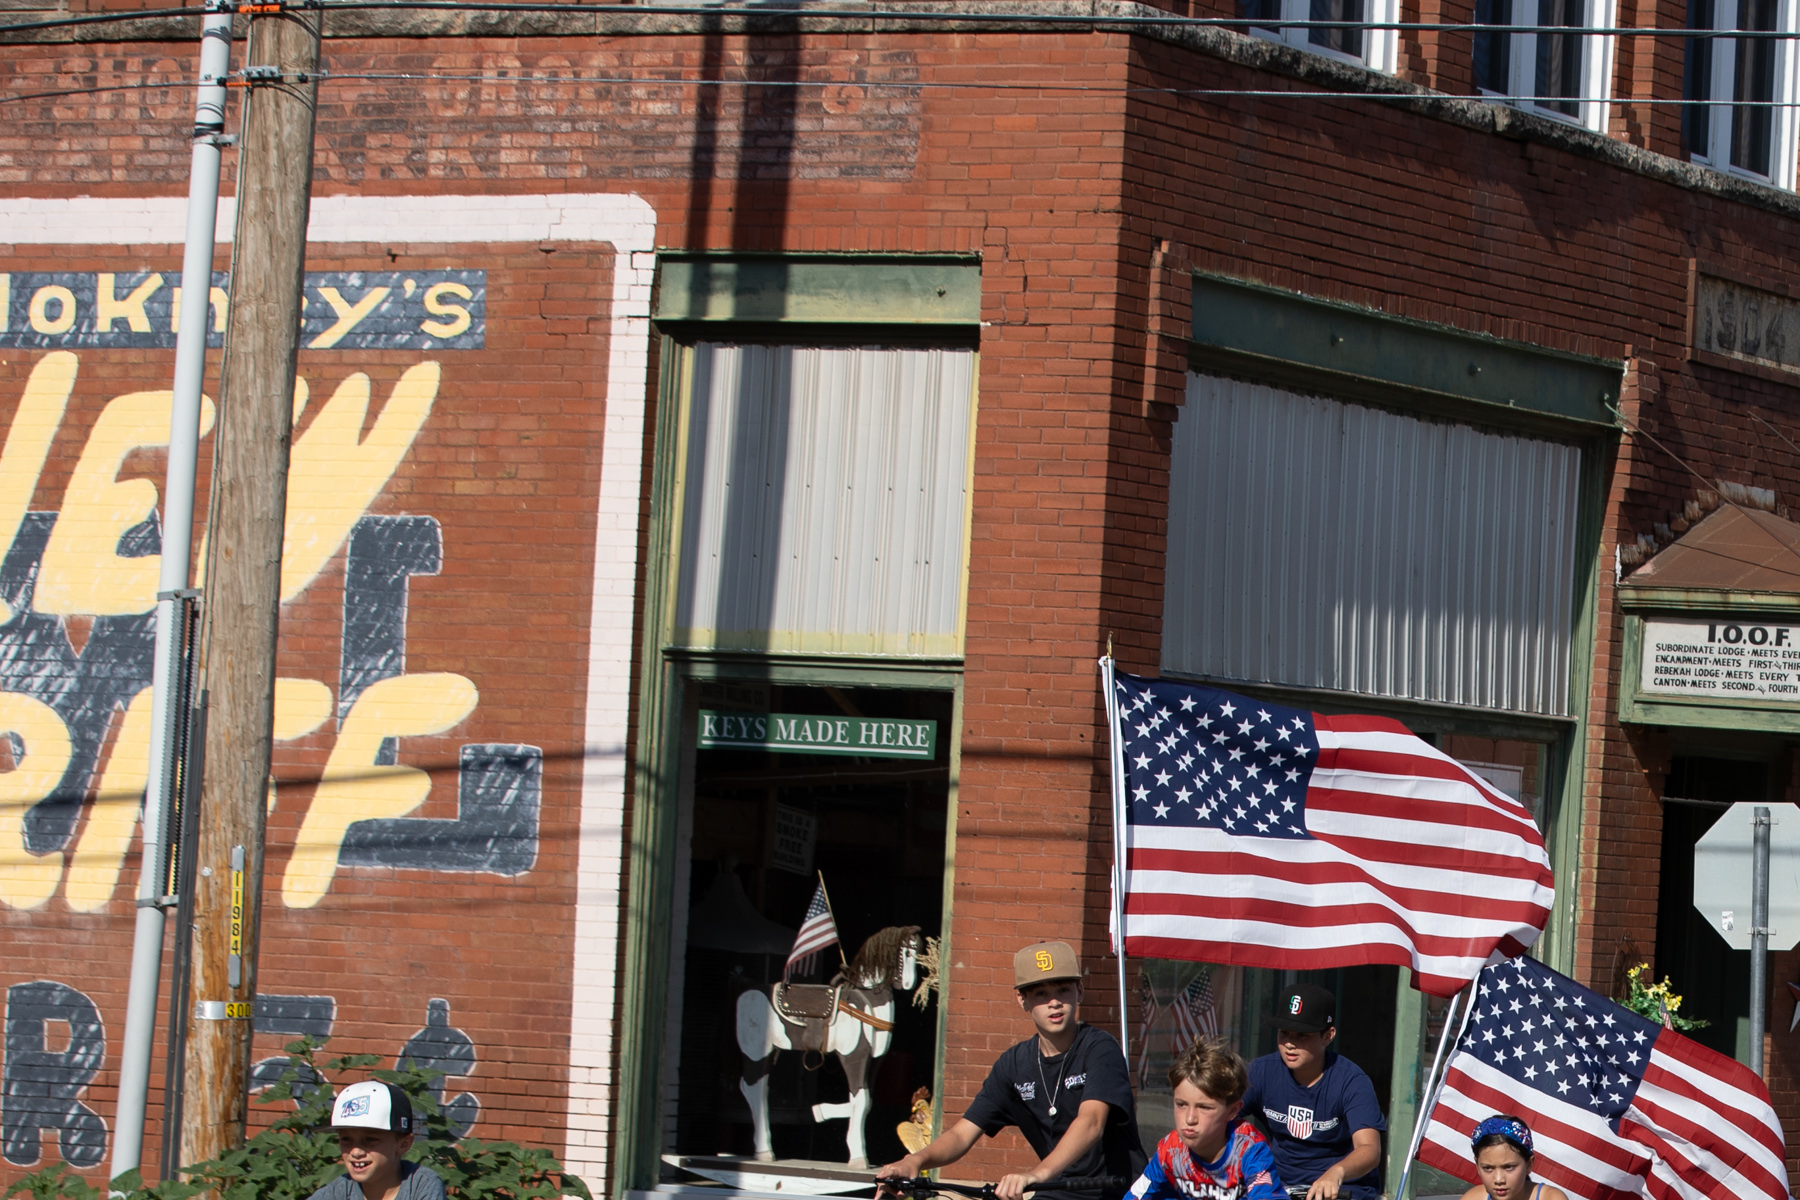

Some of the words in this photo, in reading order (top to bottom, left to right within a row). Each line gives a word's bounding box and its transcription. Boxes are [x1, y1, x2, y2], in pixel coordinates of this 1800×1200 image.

[1707, 624, 1792, 648] I.O.O.F.
[1655, 643, 1715, 655] SUBORDINATE
[1718, 647, 1745, 656] LODGE
[1751, 649, 1779, 658] MEETS
[1655, 655, 1709, 666] ENCAMPMENT
[1712, 658, 1742, 667] MEETS
[1749, 660, 1773, 669] FIRST
[1654, 667, 1691, 677] REBEKAH
[1694, 669, 1720, 678] LODGE
[1725, 670, 1754, 680] MEETS
[1759, 672, 1789, 682] EVERY
[1653, 678, 1687, 687] CANTON
[1690, 680, 1717, 689] MEETS
[1721, 682, 1755, 691] SECOND
[1768, 684, 1798, 694] FOURTH
[702, 714, 767, 740] KEYS
[775, 718, 850, 744] MADE
[858, 722, 930, 748] HERE
[777, 822, 809, 842] SMOKE
[778, 837, 803, 855] FREE
[1289, 1107, 1312, 1121] USA
